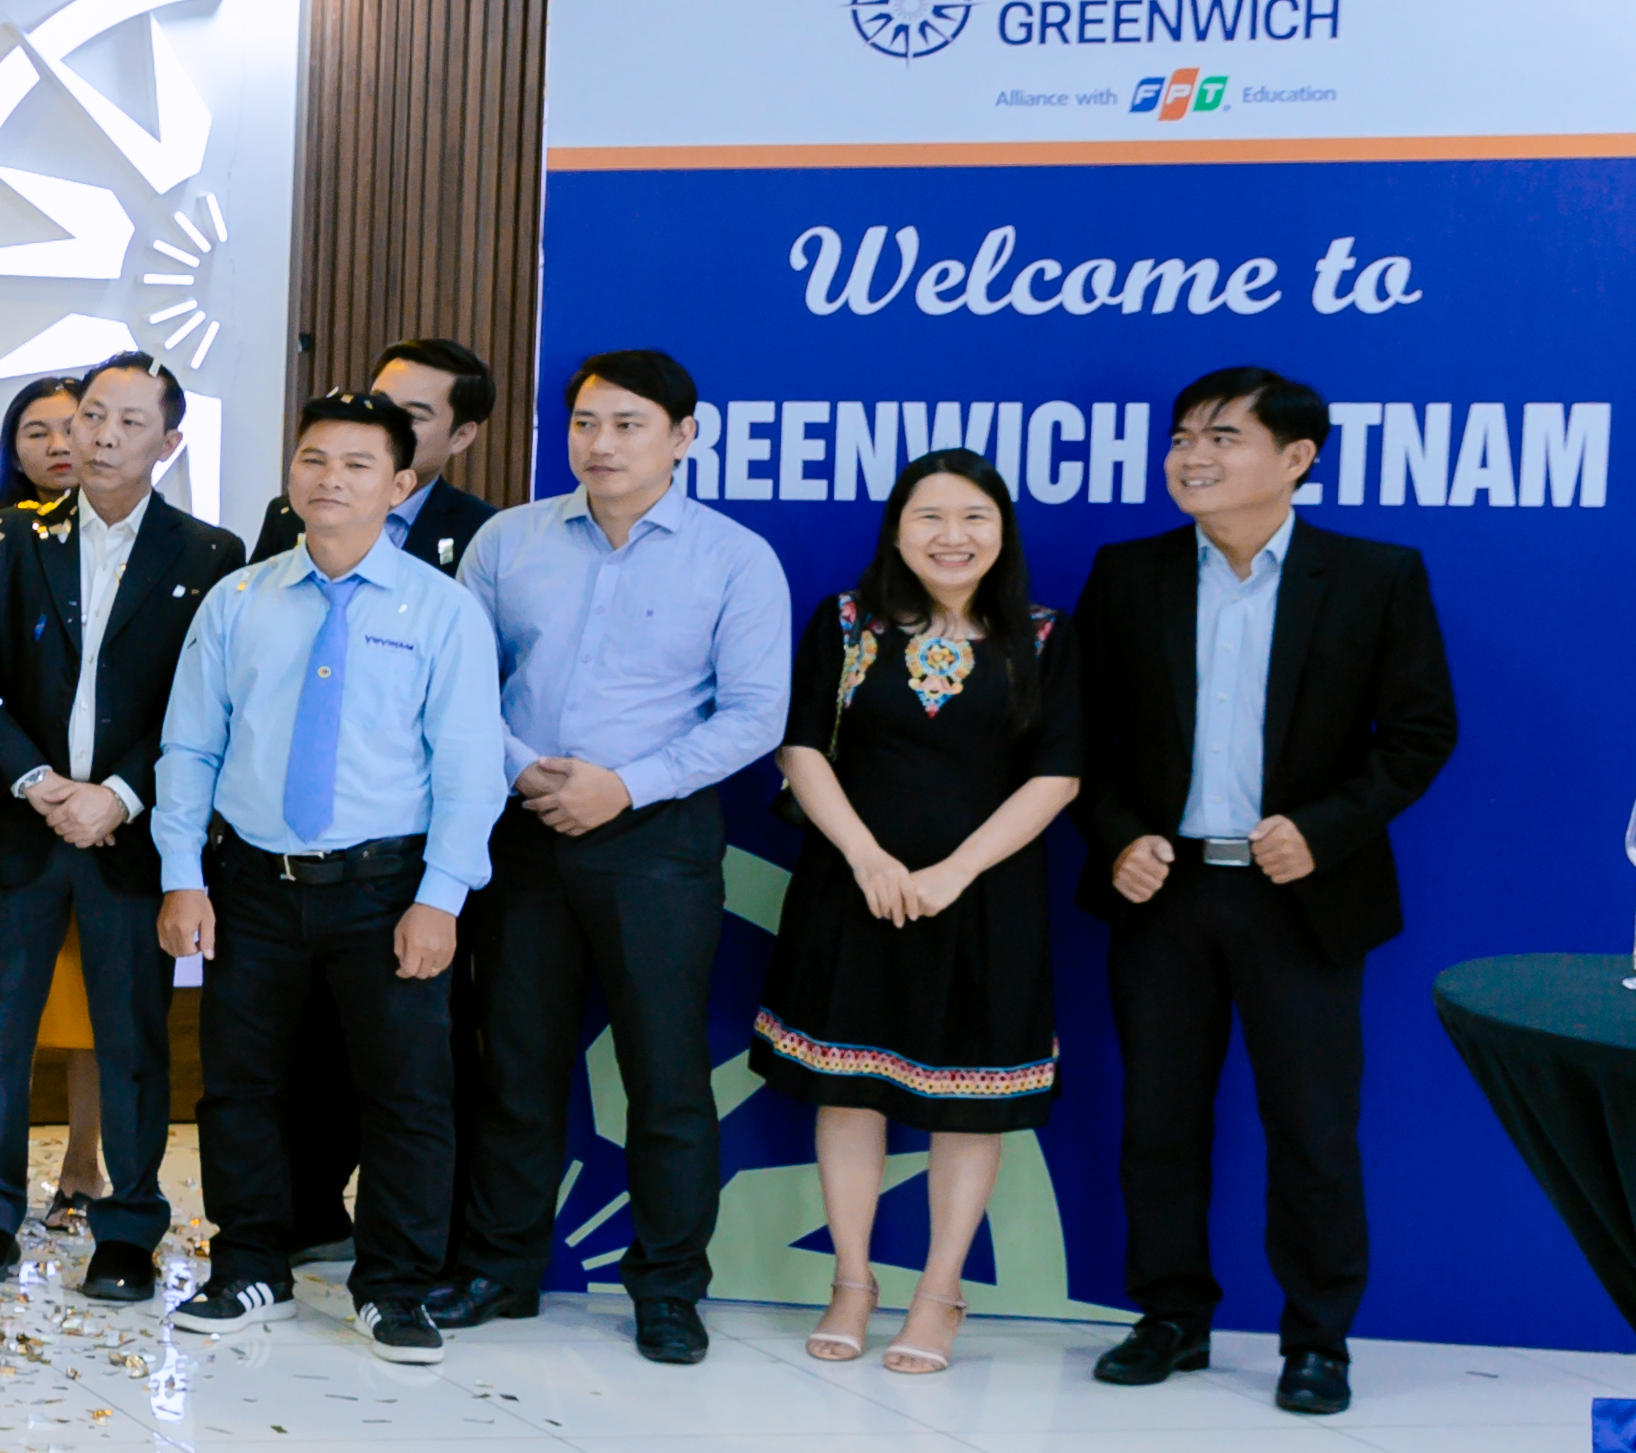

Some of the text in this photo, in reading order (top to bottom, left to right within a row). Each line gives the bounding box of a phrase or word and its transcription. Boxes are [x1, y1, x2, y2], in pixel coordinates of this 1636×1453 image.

[995, 75, 1337, 115] Alliance with FPT Education
[788, 223, 1425, 318] Welcome to
[672, 400, 1151, 505] REENWICH
